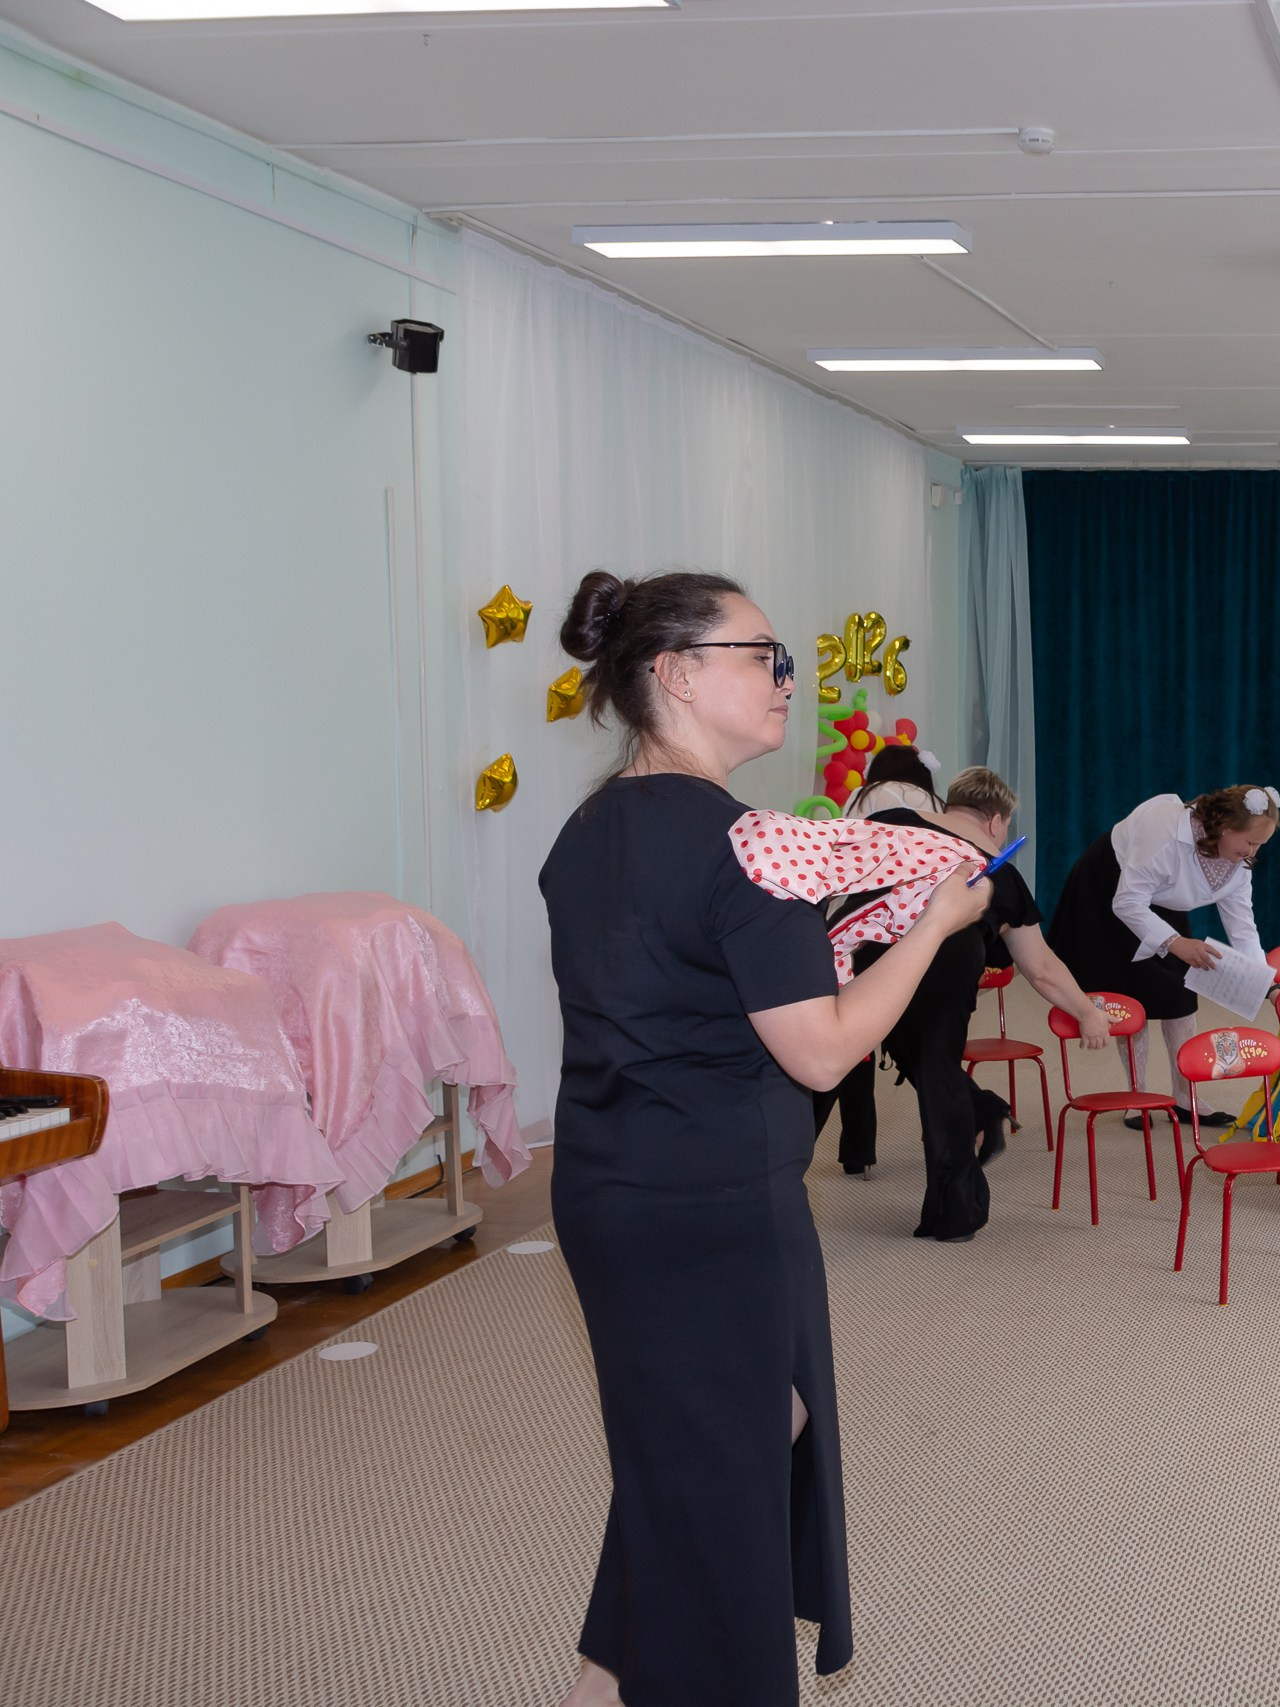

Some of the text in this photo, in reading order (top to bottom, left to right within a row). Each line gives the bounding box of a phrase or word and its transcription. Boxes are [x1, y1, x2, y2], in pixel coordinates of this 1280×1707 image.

[817, 611, 911, 704] 2026
[1239, 1039, 1257, 1049] little
[1240, 1047, 1268, 1060] tiger
